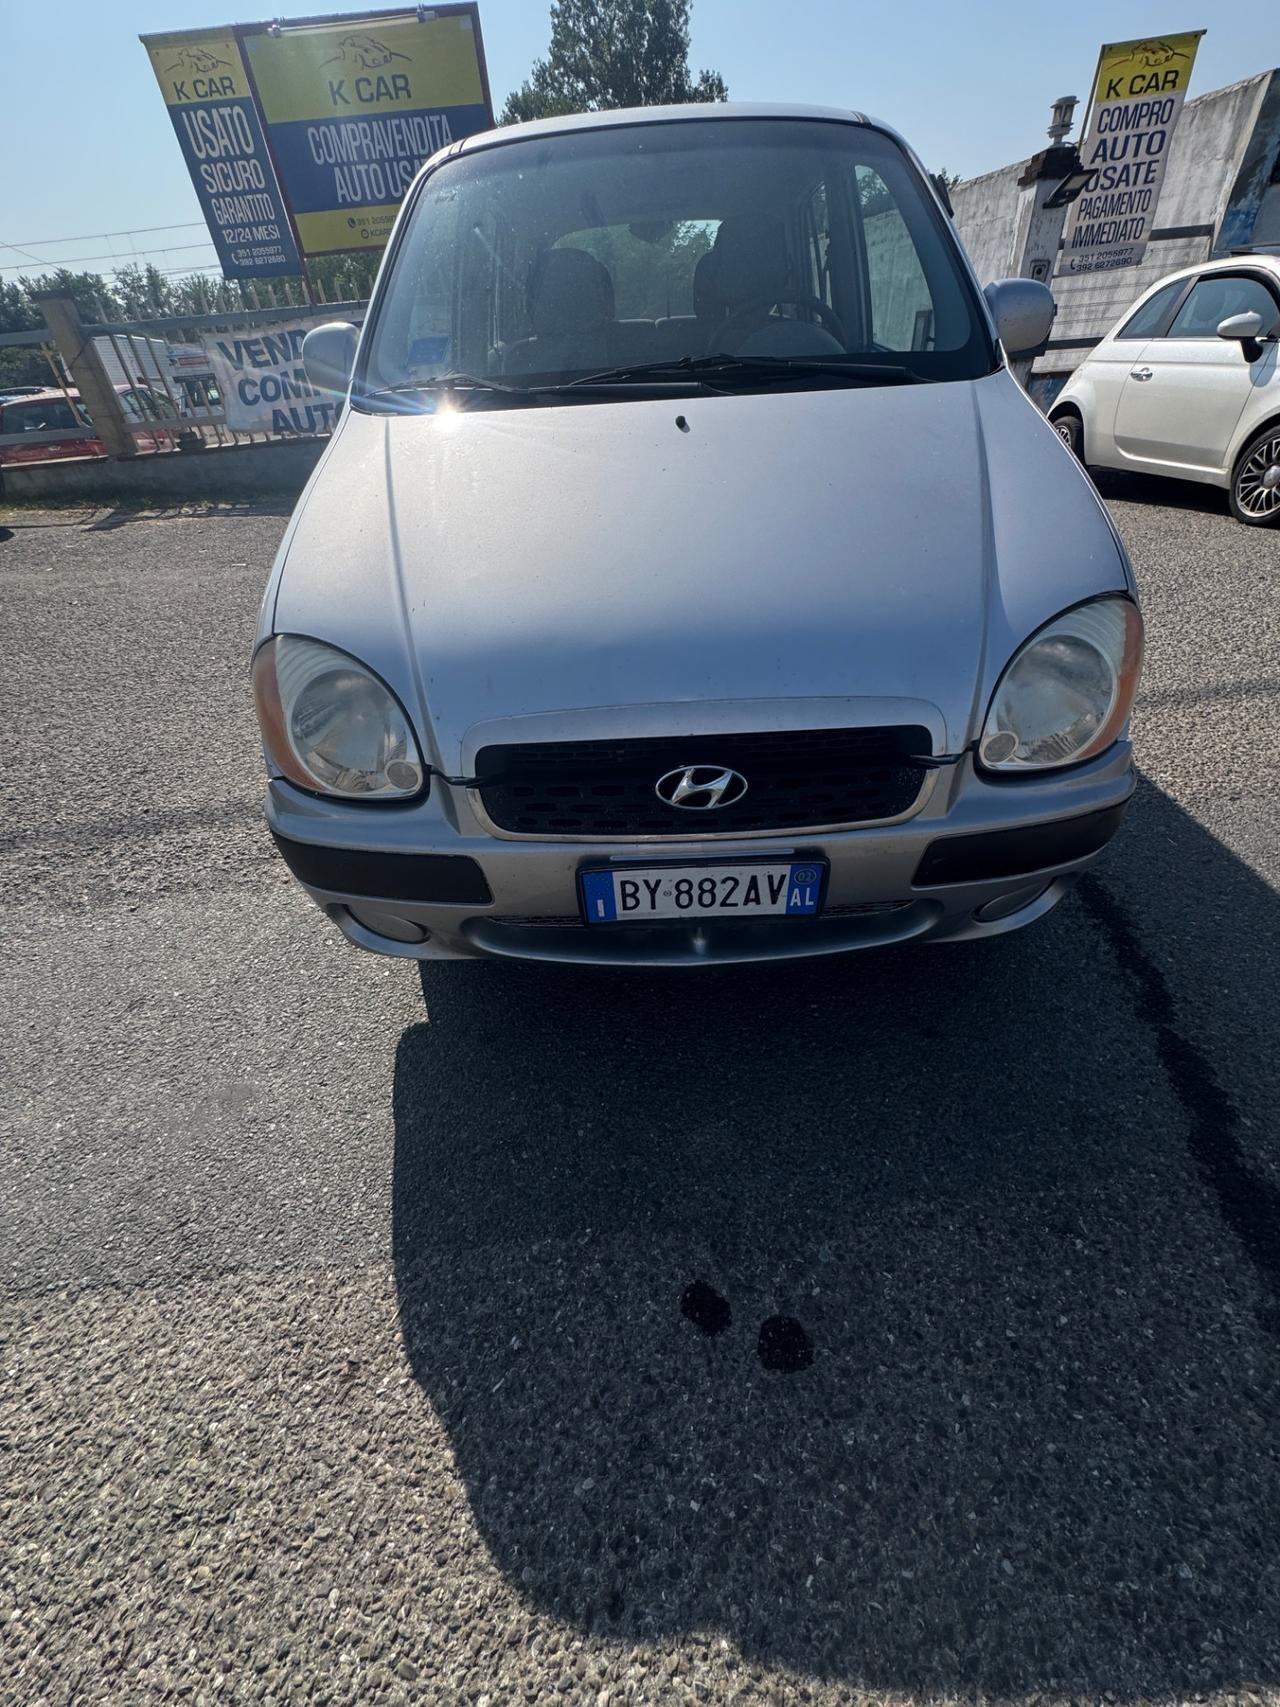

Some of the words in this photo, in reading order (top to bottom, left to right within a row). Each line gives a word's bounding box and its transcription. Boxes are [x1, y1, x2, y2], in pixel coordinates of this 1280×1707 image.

[173, 80, 191, 101] K
[193, 76, 236, 98] CAR
[328, 80, 350, 106] K
[355, 74, 412, 102] CAR
[1106, 77, 1125, 99] K
[1129, 70, 1179, 95] CAR
[182, 105, 255, 159] USATO
[1097, 98, 1174, 134] COMPRO
[307, 114, 453, 165] COMPRAVENDITA
[1090, 130, 1166, 165] AUTO
[200, 159, 266, 194] SICURO
[334, 163, 386, 203] AUTO
[211, 193, 276, 225] GARANTITO
[1077, 188, 1152, 221] PAGAMENTO
[222, 227, 253, 244] 12/24
[252, 224, 280, 241] MESI
[1071, 217, 1146, 249] IMMEDIATO
[1076, 263, 1093, 272] 392
[1079, 254, 1095, 263] 351
[238, 368, 321, 406] COM
[597, 899, 605, 917] I
[790, 887, 815, 906] AL
